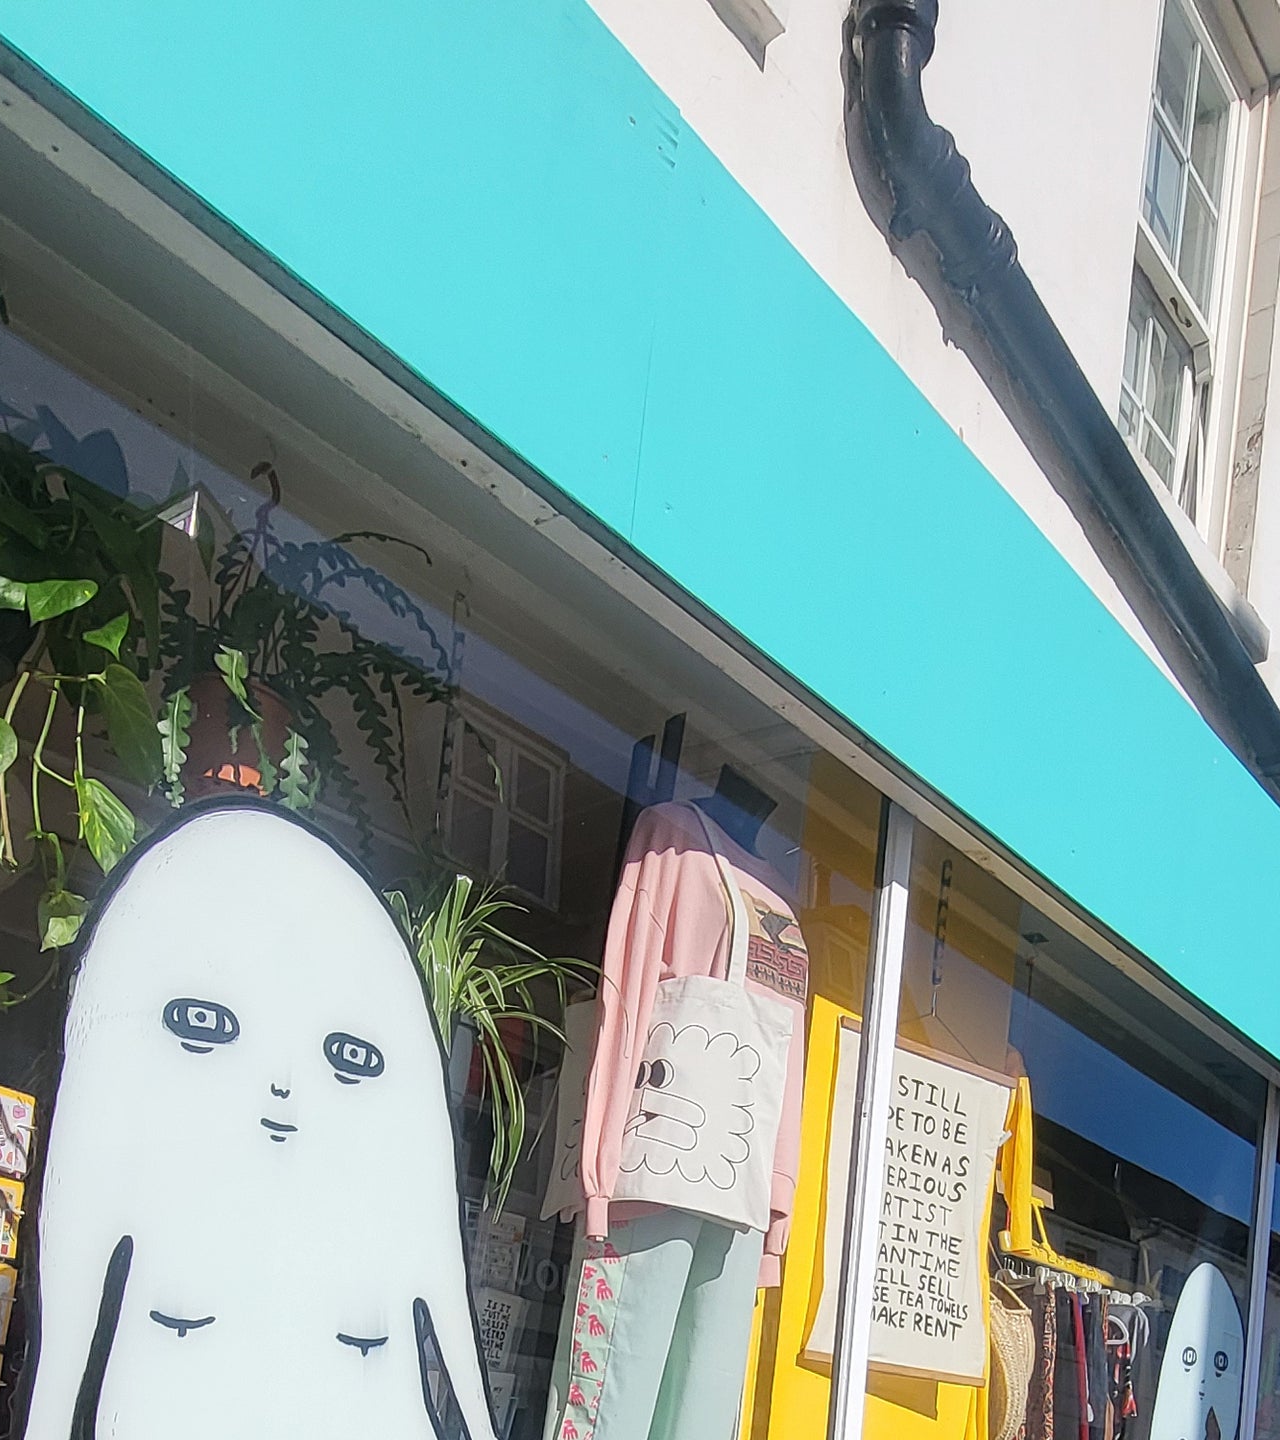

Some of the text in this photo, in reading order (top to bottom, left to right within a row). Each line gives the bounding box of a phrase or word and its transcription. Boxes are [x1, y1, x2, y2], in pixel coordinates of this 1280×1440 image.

[897, 1074, 967, 1118] STILL
[911, 1111, 936, 1136] TO
[941, 1117, 968, 1145] BE
[885, 1137, 971, 1178] AKEN AS
[886, 1164, 968, 1203] ERIOUS
[883, 1191, 953, 1227] RTIST
[891, 1223, 919, 1244] IN
[925, 1230, 963, 1256] THE
[877, 1242, 961, 1279] ANTIME
[897, 1288, 924, 1310] TEA
[928, 1295, 969, 1321] TOWELS
[917, 1273, 955, 1302] SELL
[913, 1311, 963, 1342] RENT
